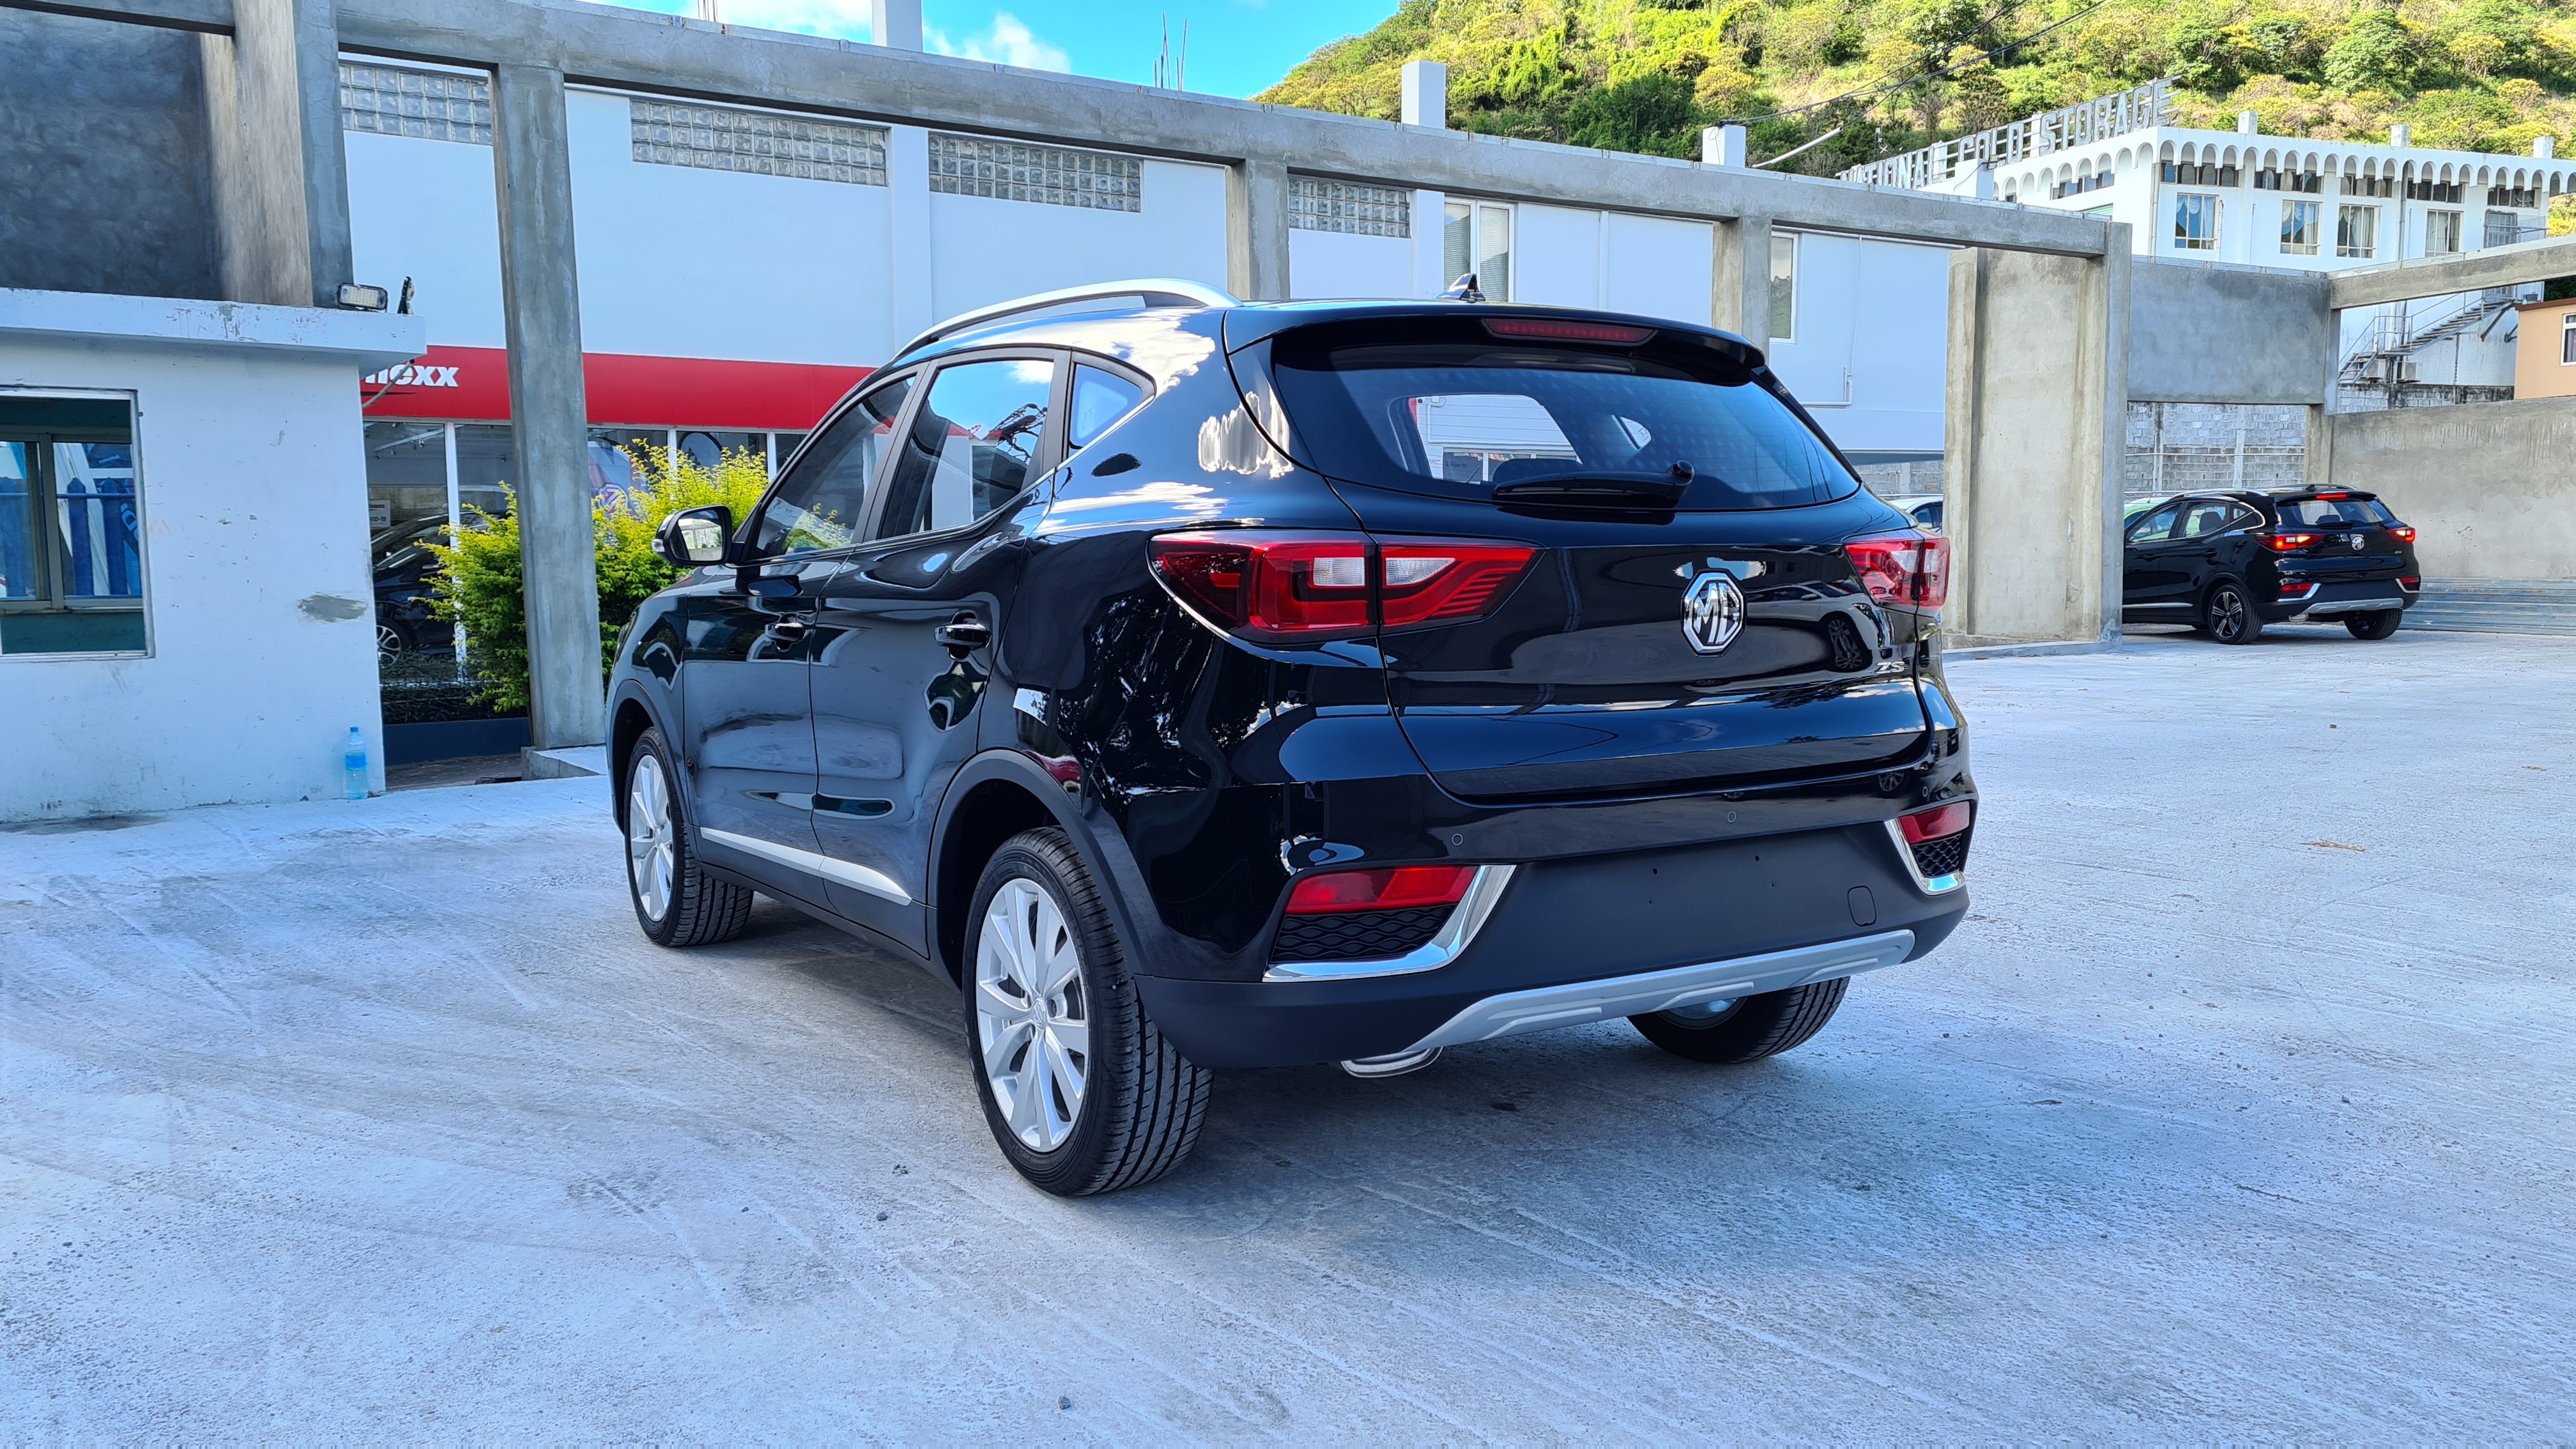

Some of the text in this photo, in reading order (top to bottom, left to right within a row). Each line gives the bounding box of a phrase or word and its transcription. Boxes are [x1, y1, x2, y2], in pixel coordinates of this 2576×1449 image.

[1959, 122, 2024, 168] COLD
[2039, 79, 2172, 157] STORAGE
[1692, 580, 1741, 645] MG
[1875, 661, 1905, 675] ZS
